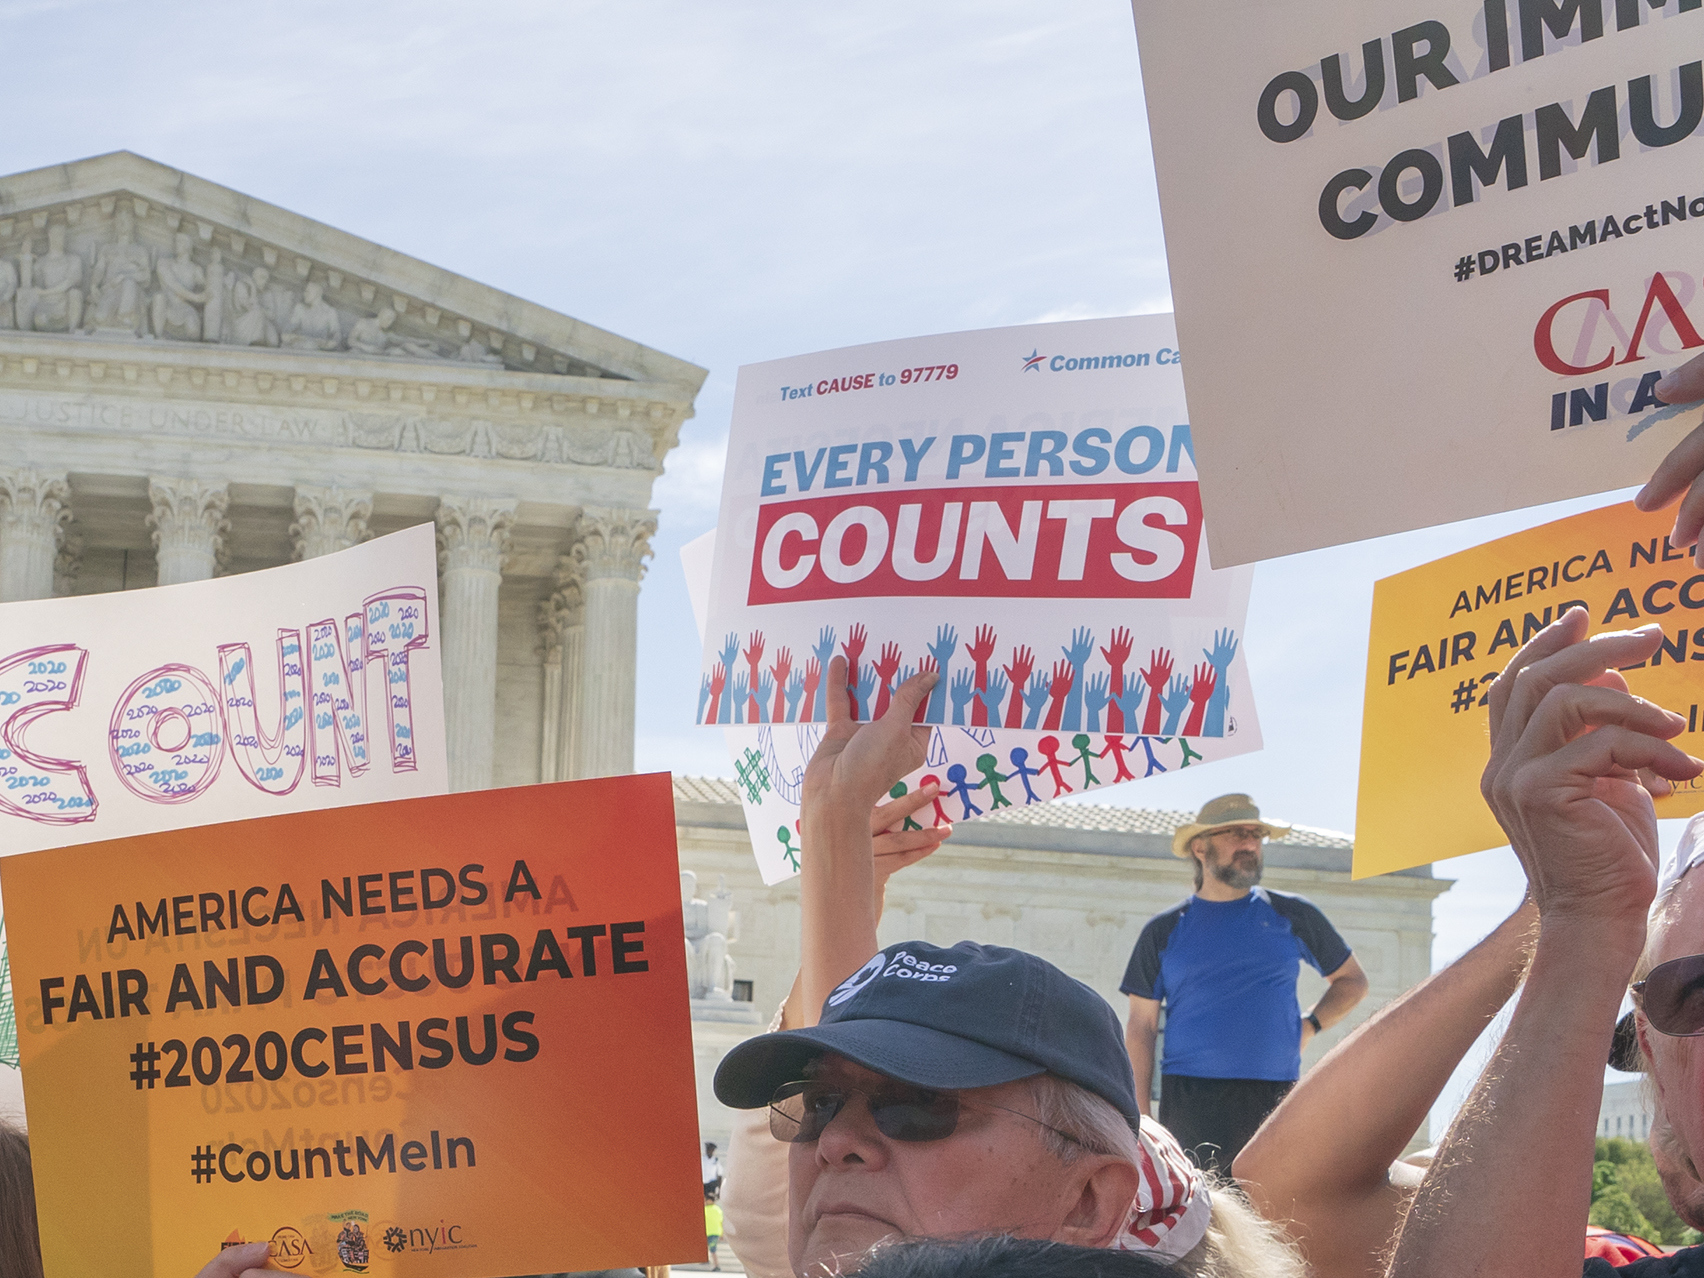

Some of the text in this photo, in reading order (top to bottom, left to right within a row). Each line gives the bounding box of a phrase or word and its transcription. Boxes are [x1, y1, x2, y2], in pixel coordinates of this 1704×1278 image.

[1257, 20, 1460, 143] OUR
[1318, 60, 1704, 240] COMMU
[1453, 194, 1704, 282] #DREAMActNo
[1533, 271, 1704, 377] CA
[780, 364, 959, 401] Text CAUSE to 97779
[1050, 353, 1150, 372] Common
[1550, 382, 1609, 431] IN
[759, 436, 936, 497] EVERY
[760, 496, 1188, 591] COUNTS
[1449, 535, 1704, 619] AMERICA NE
[28, 661, 67, 674] 2020
[1387, 631, 1477, 686] FAIR
[23, 680, 67, 693] 2020
[5, 776, 50, 789] 2020
[22, 792, 57, 804] 2020
[106, 859, 542, 943] AMERICA NEEDS A
[39, 966, 150, 1025] FAIR
[165, 954, 285, 1018] AND
[302, 920, 649, 1003] ACCURATE
[883, 964, 950, 982] Corps
[129, 1010, 540, 1090] #2020CENSUS
[190, 1129, 477, 1184] #CountMeIn
[410, 1219, 463, 1254] nyic
